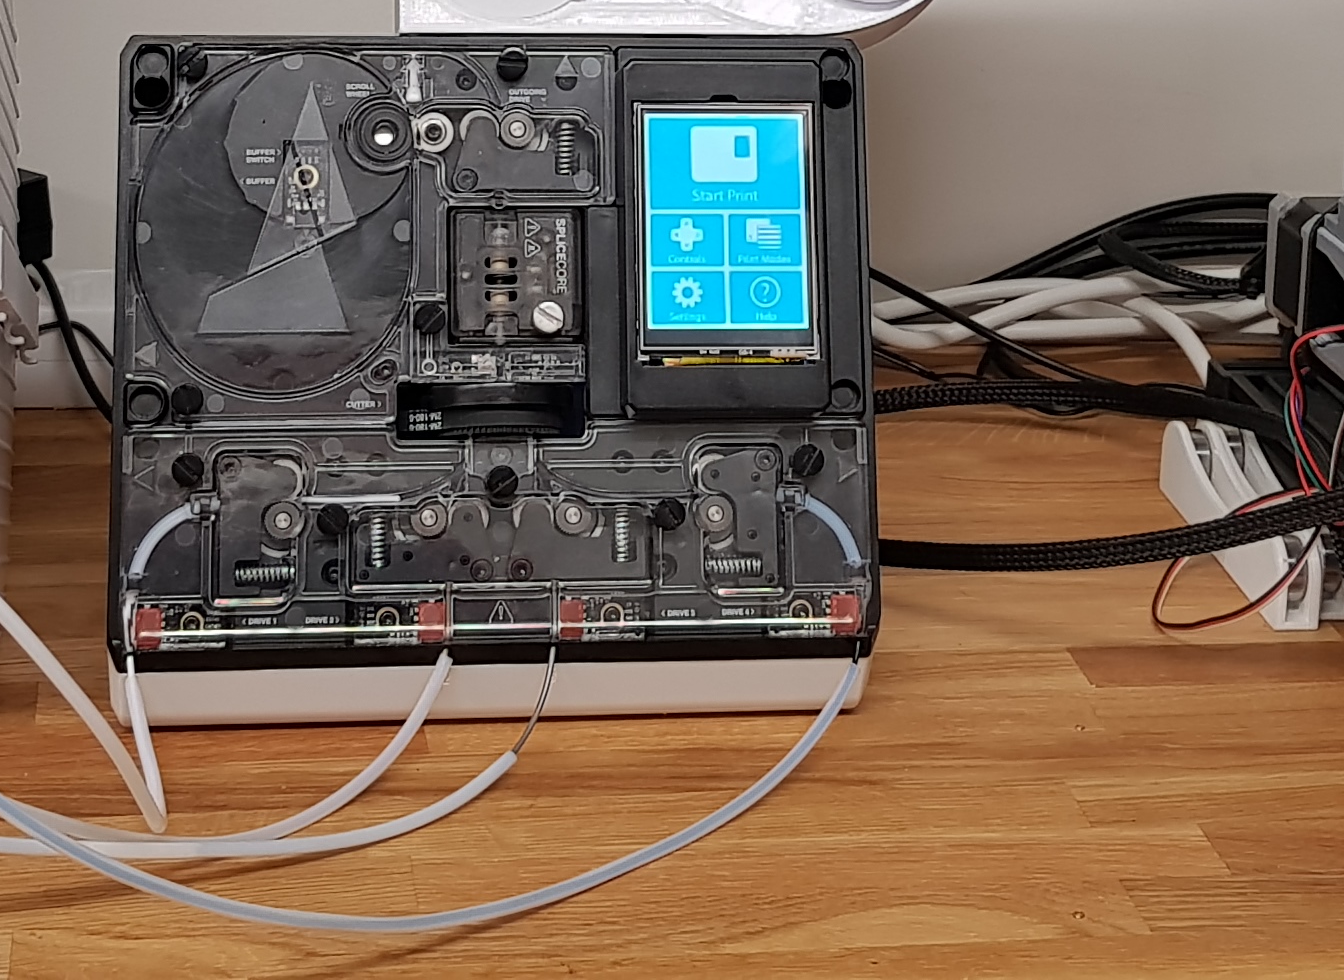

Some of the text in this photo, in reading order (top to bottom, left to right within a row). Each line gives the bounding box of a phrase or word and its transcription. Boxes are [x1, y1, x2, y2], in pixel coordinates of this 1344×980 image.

[246, 148, 276, 156] BUFFER
[245, 177, 276, 185] BUFFER
[691, 188, 759, 202] Start Print
[556, 218, 568, 294] SPLICECORE
